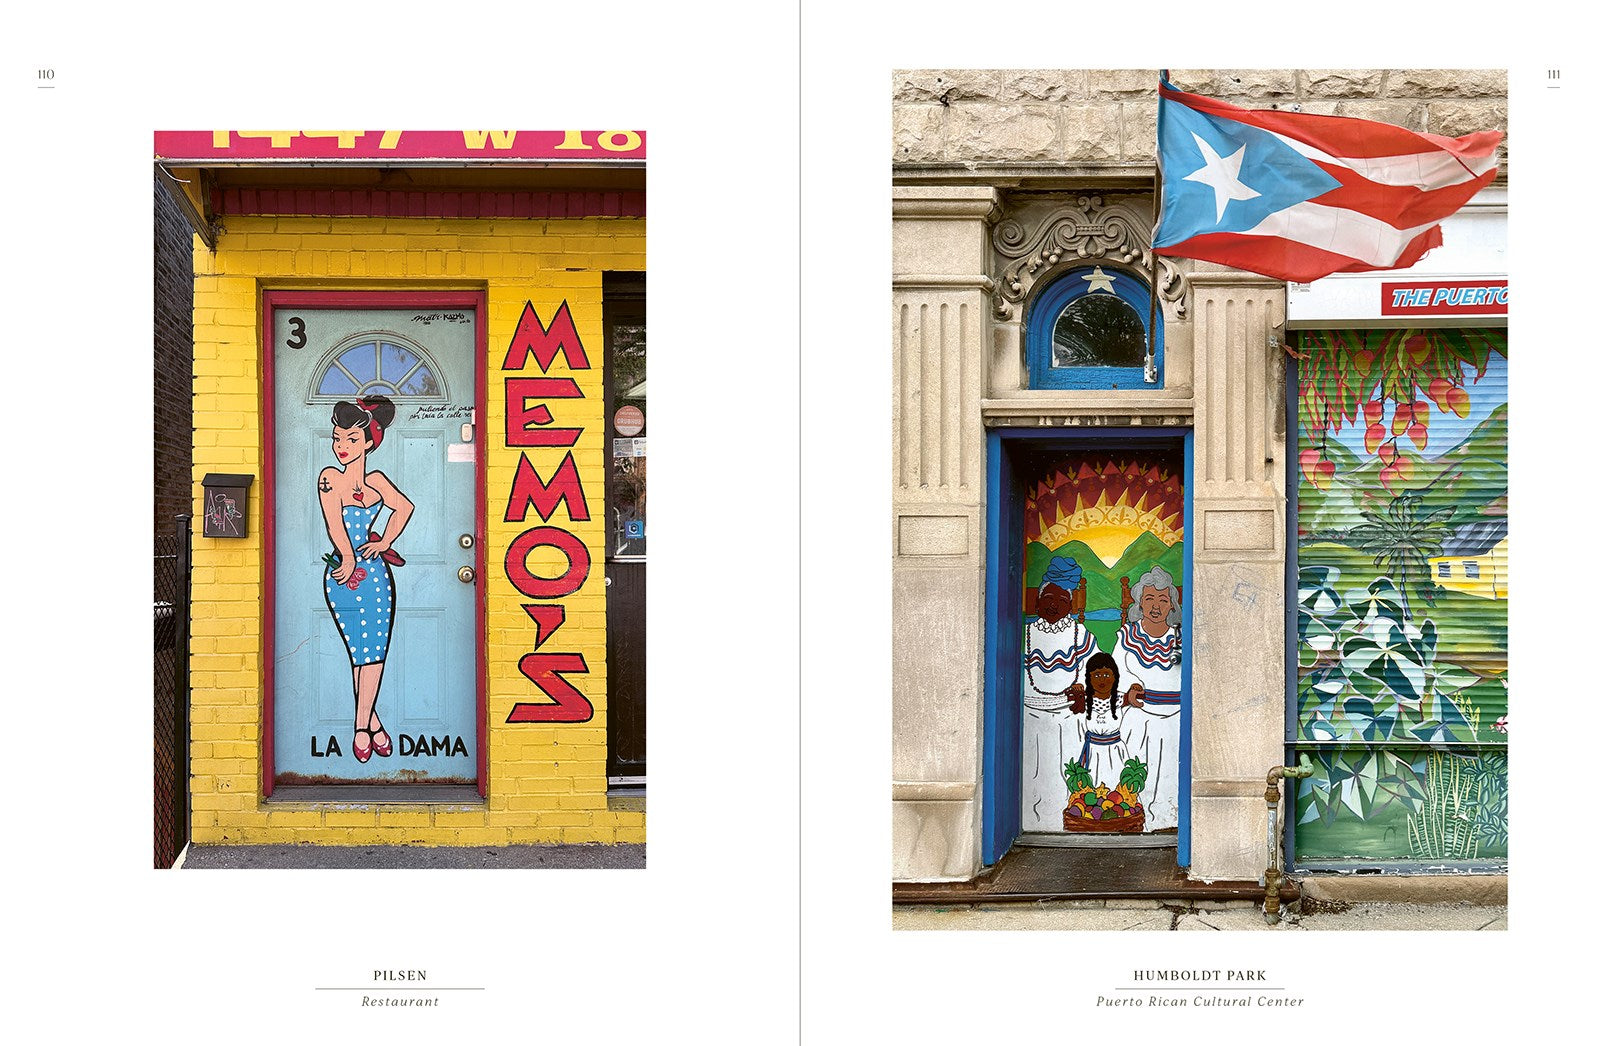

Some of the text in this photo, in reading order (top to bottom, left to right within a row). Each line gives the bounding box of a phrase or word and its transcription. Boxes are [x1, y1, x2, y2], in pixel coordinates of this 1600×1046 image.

[1392, 289, 1433, 307] THE
[286, 316, 307, 350] 3
[311, 734, 469, 757] LA DAMA
